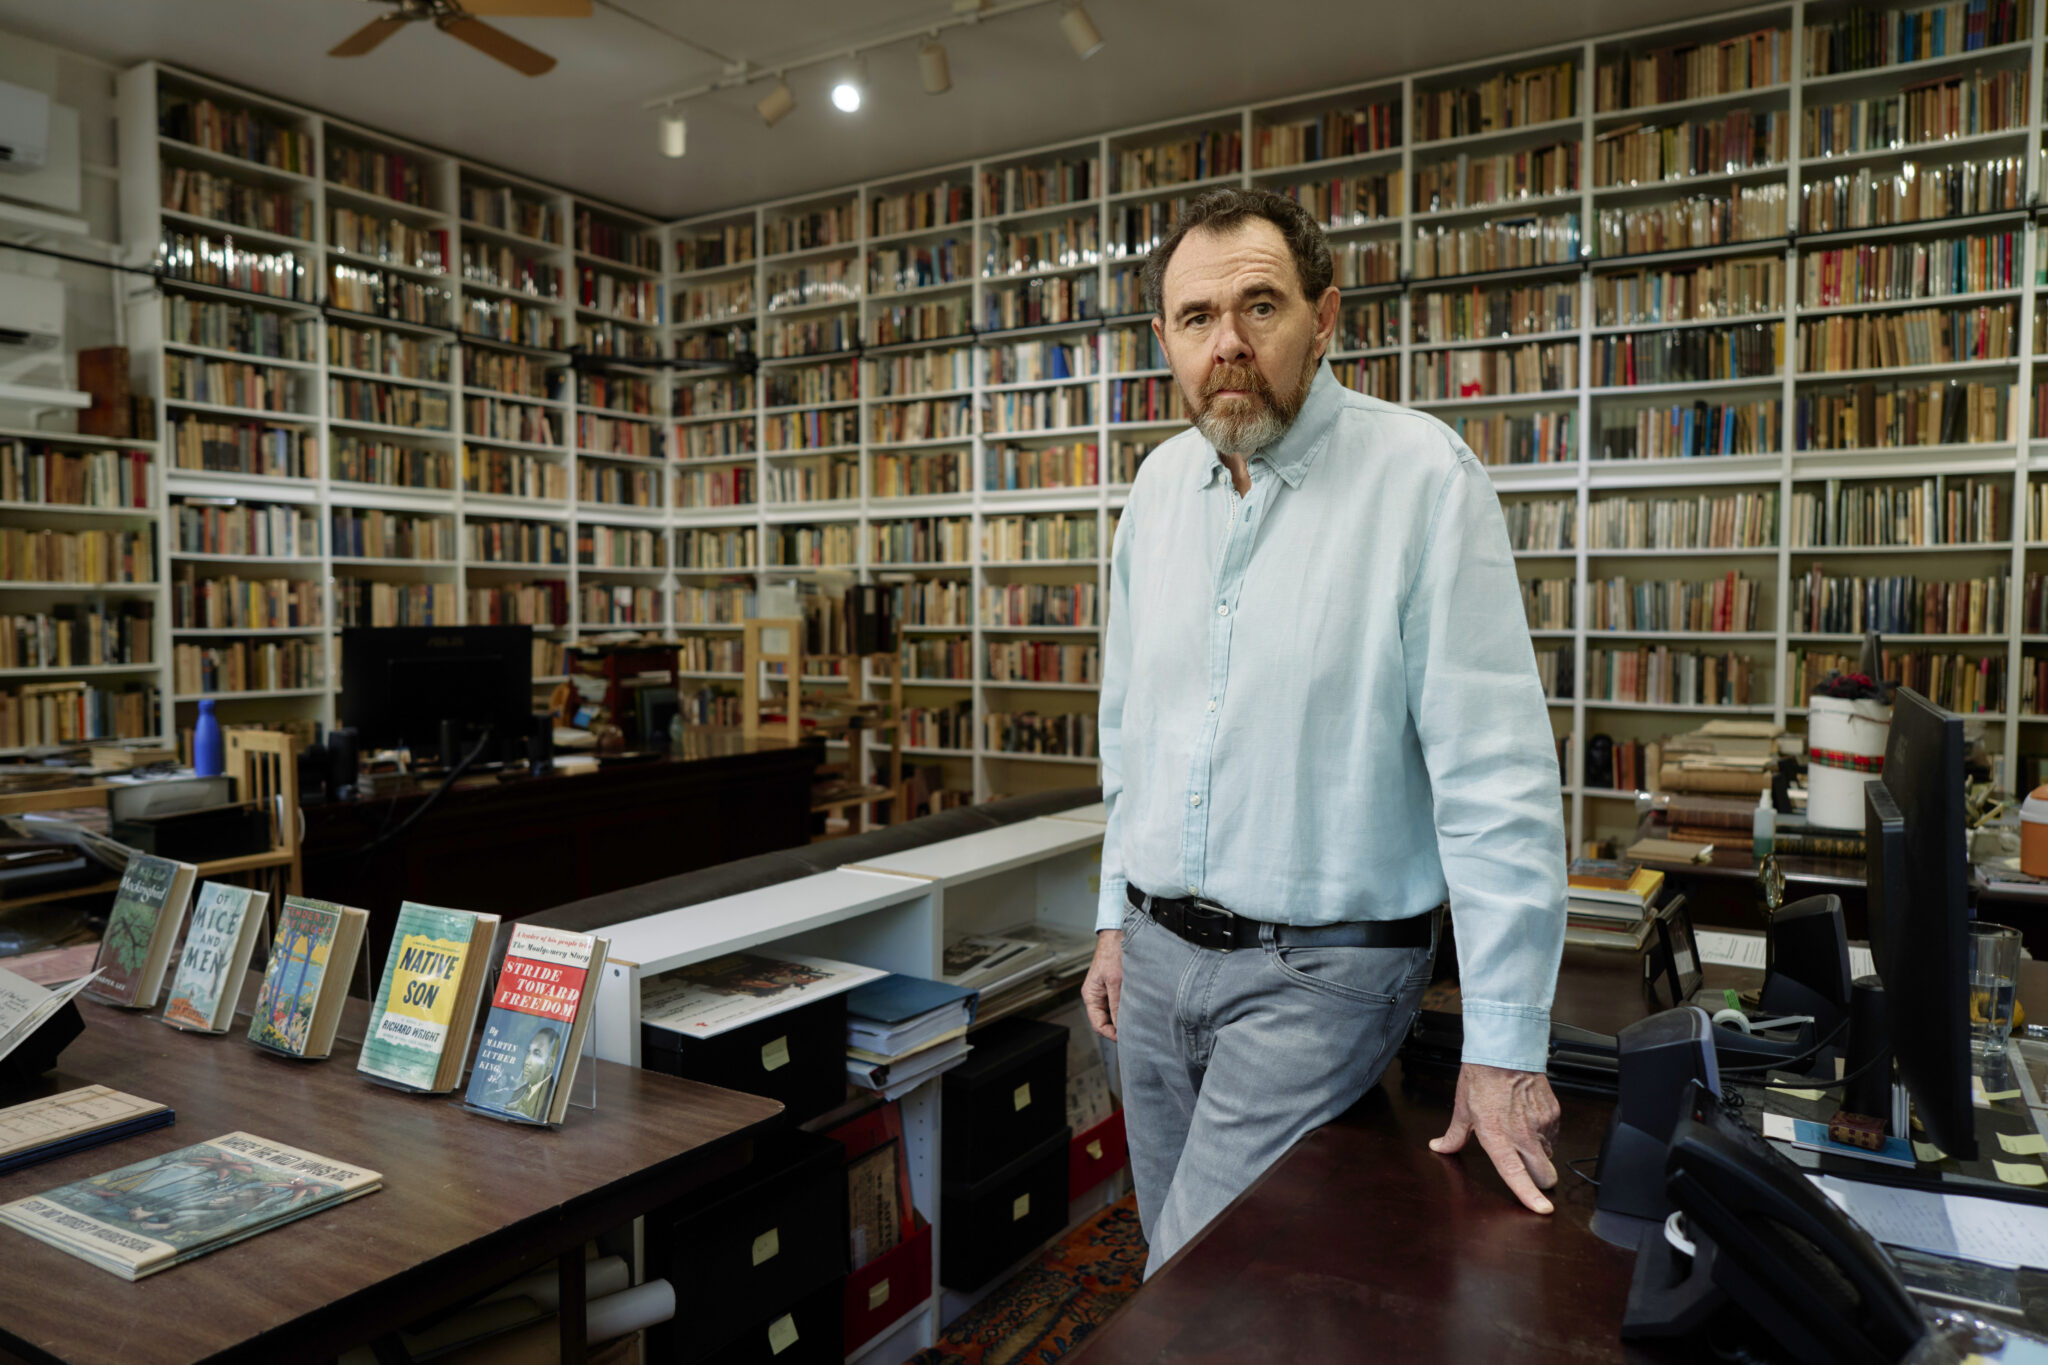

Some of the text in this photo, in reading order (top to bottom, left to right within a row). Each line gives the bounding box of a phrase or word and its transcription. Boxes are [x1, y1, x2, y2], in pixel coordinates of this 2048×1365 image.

[120, 876, 167, 903] Mockingbird
[192, 906, 240, 935] MICE
[287, 907, 320, 921] TENDER
[201, 934, 220, 948] AND
[299, 923, 332, 937] NIGHT
[522, 932, 538, 941] leader
[558, 939, 577, 947] people
[185, 947, 225, 974] MEN
[399, 947, 459, 980] NATIVE
[512, 941, 590, 963] The Montgomery Story
[505, 960, 563, 983] STRIDE
[403, 980, 440, 1009] SON
[516, 978, 580, 1001] TOWARD
[499, 991, 576, 1018] FREEDOM
[382, 1019, 411, 1036] RICHARD
[412, 1027, 441, 1043] WRIGHT
[488, 1026, 499, 1037] By
[482, 1049, 517, 1065] LUTHER
[485, 1038, 518, 1053] MARTIN
